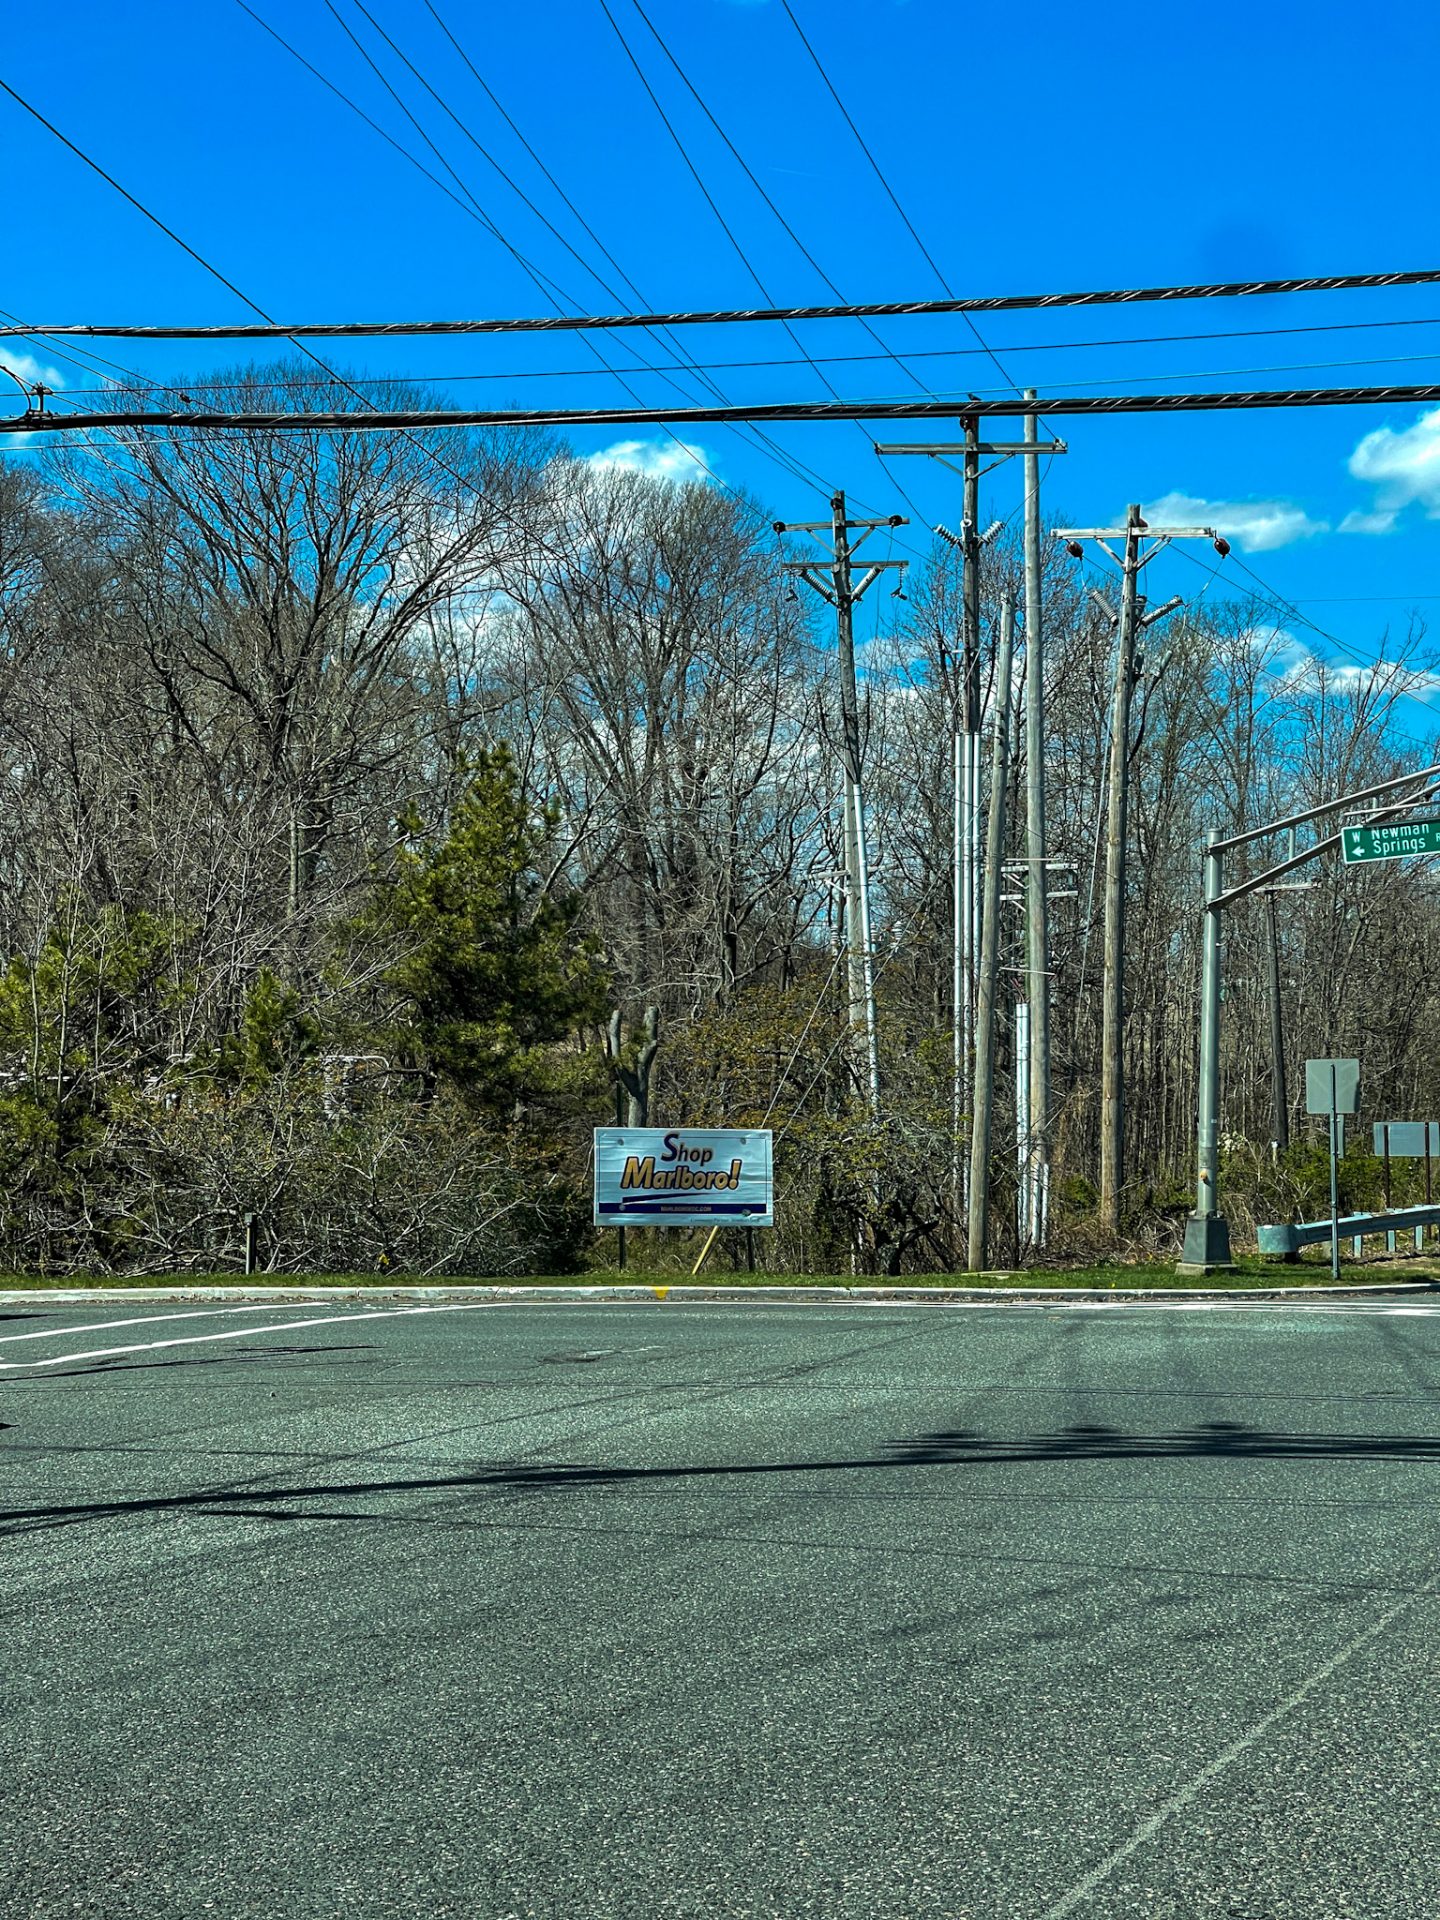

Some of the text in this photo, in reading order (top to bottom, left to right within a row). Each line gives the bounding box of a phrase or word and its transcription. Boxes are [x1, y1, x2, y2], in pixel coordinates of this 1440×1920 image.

[1352, 831, 1361, 843] W
[1371, 823, 1430, 840] Newman
[1373, 837, 1426, 856] Springs
[661, 1131, 713, 1166] Shop
[620, 1156, 742, 1190] Marlboro!
